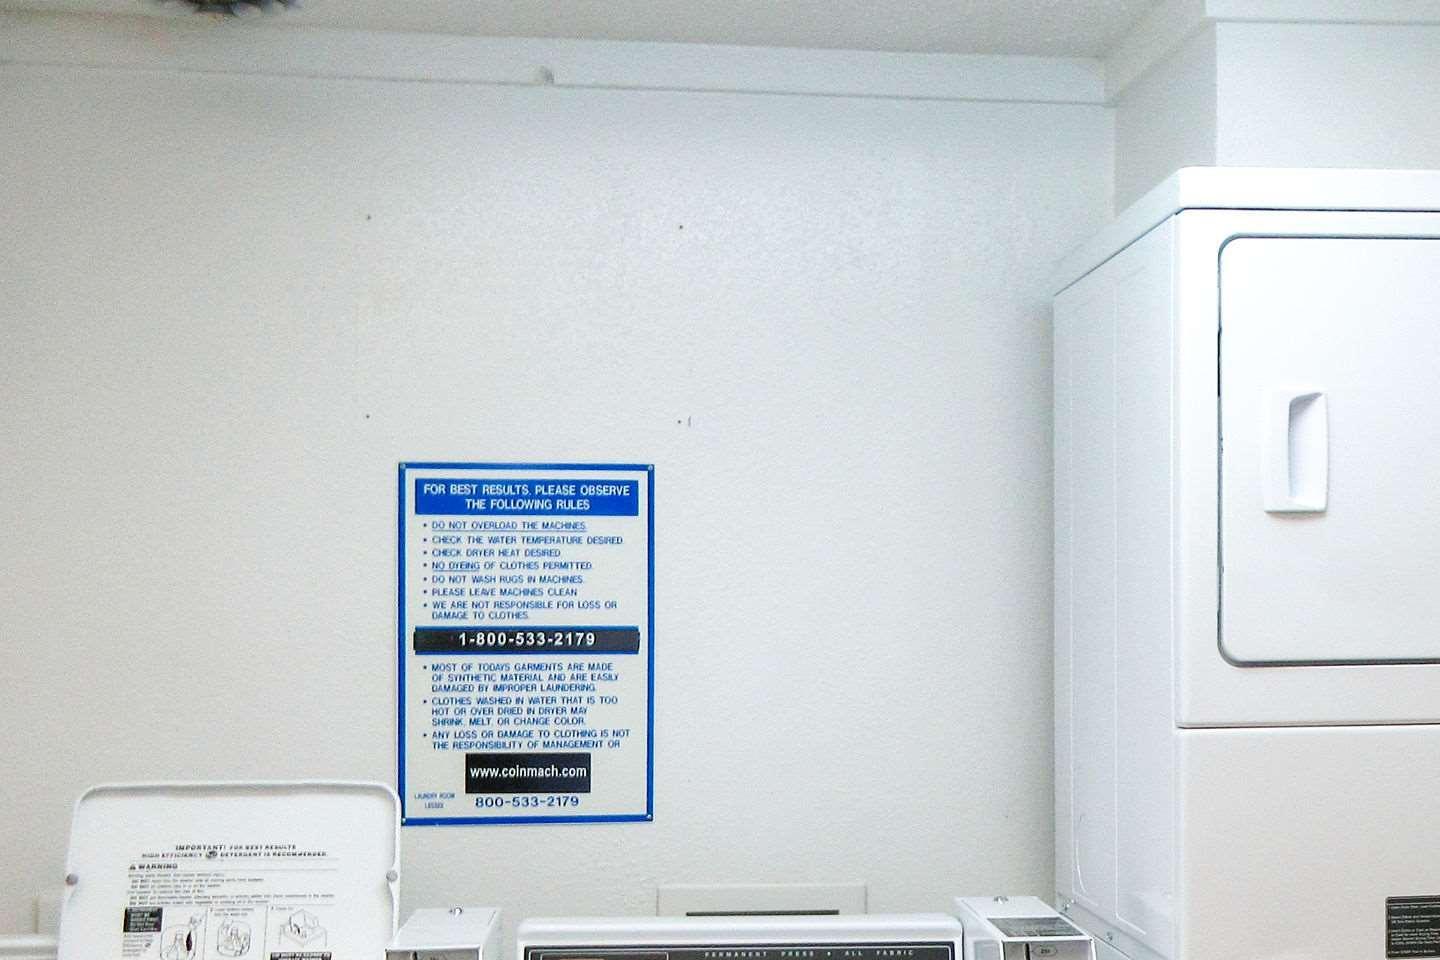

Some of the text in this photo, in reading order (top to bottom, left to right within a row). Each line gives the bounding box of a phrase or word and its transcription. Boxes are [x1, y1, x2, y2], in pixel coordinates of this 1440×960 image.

[424, 484, 446, 495] FOR
[450, 484, 478, 495] BEST
[535, 485, 576, 495] PLEASE
[580, 485, 630, 496] OBSERVE
[465, 499, 590, 510] THE FOLLOWING RULES
[459, 632, 595, 645] 1-800-533-2179
[470, 765, 587, 778] www.coinmach.com
[475, 796, 579, 808] 800-533-2179
